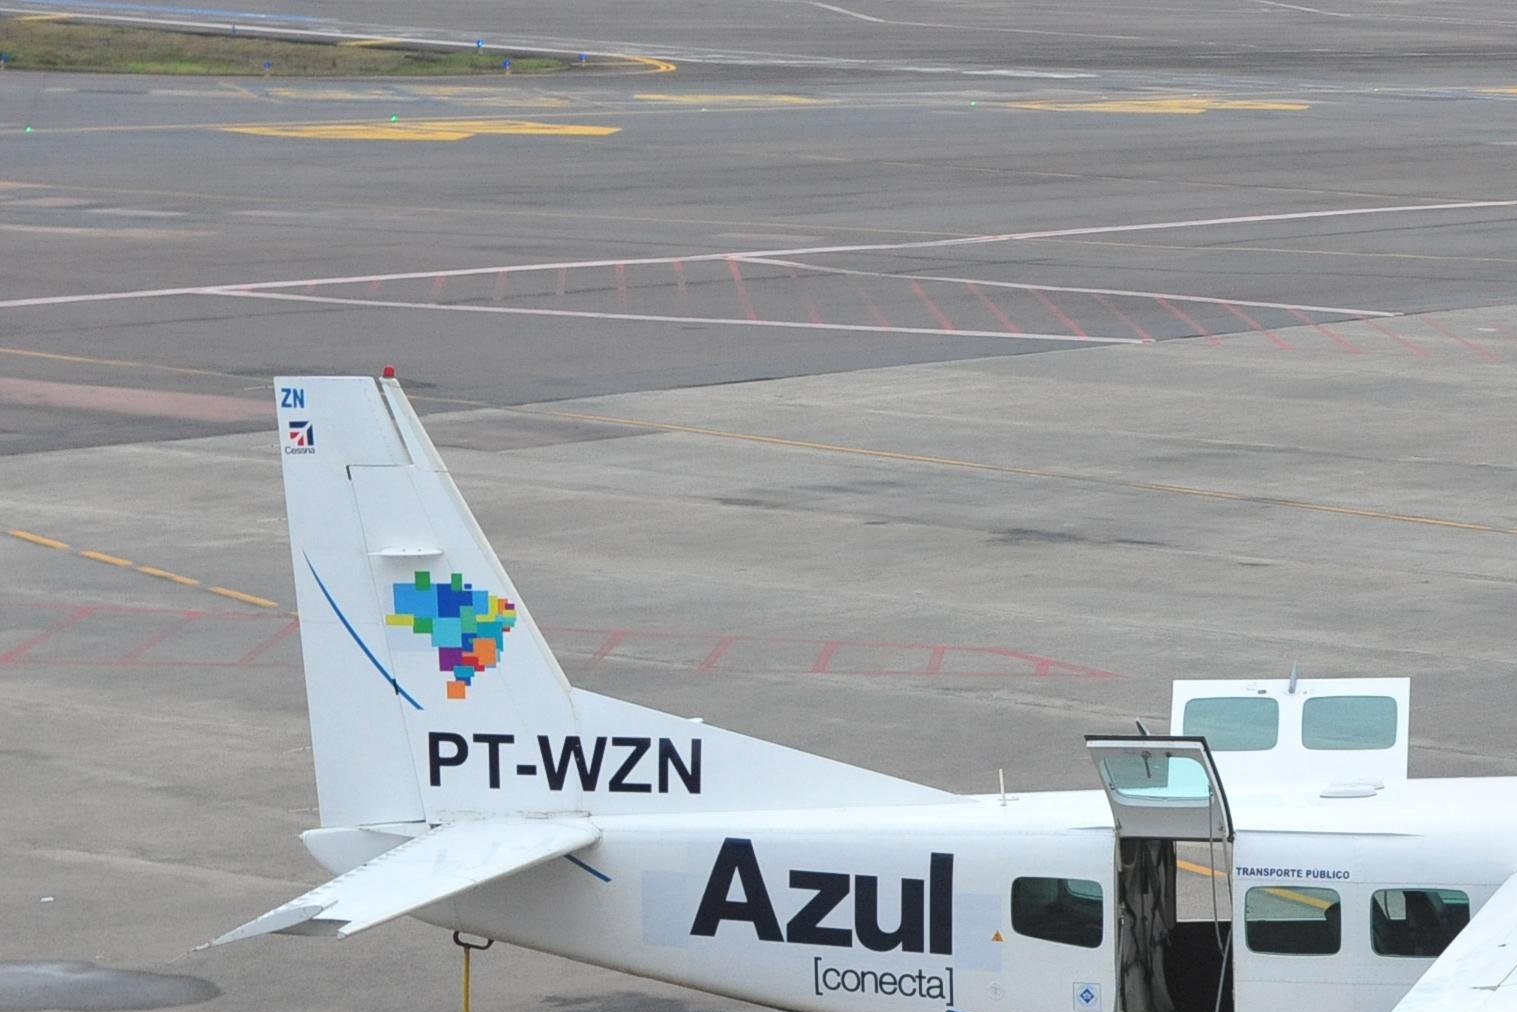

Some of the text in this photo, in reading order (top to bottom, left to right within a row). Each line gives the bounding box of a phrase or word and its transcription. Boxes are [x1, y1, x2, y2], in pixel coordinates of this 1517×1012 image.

[281, 388, 304, 408] ZN
[285, 446, 315, 454] Cessna
[428, 731, 702, 794] PT-WZN
[1236, 867, 1350, 879] TRANSPORTE PÚBLICO
[689, 837, 954, 955] Azul
